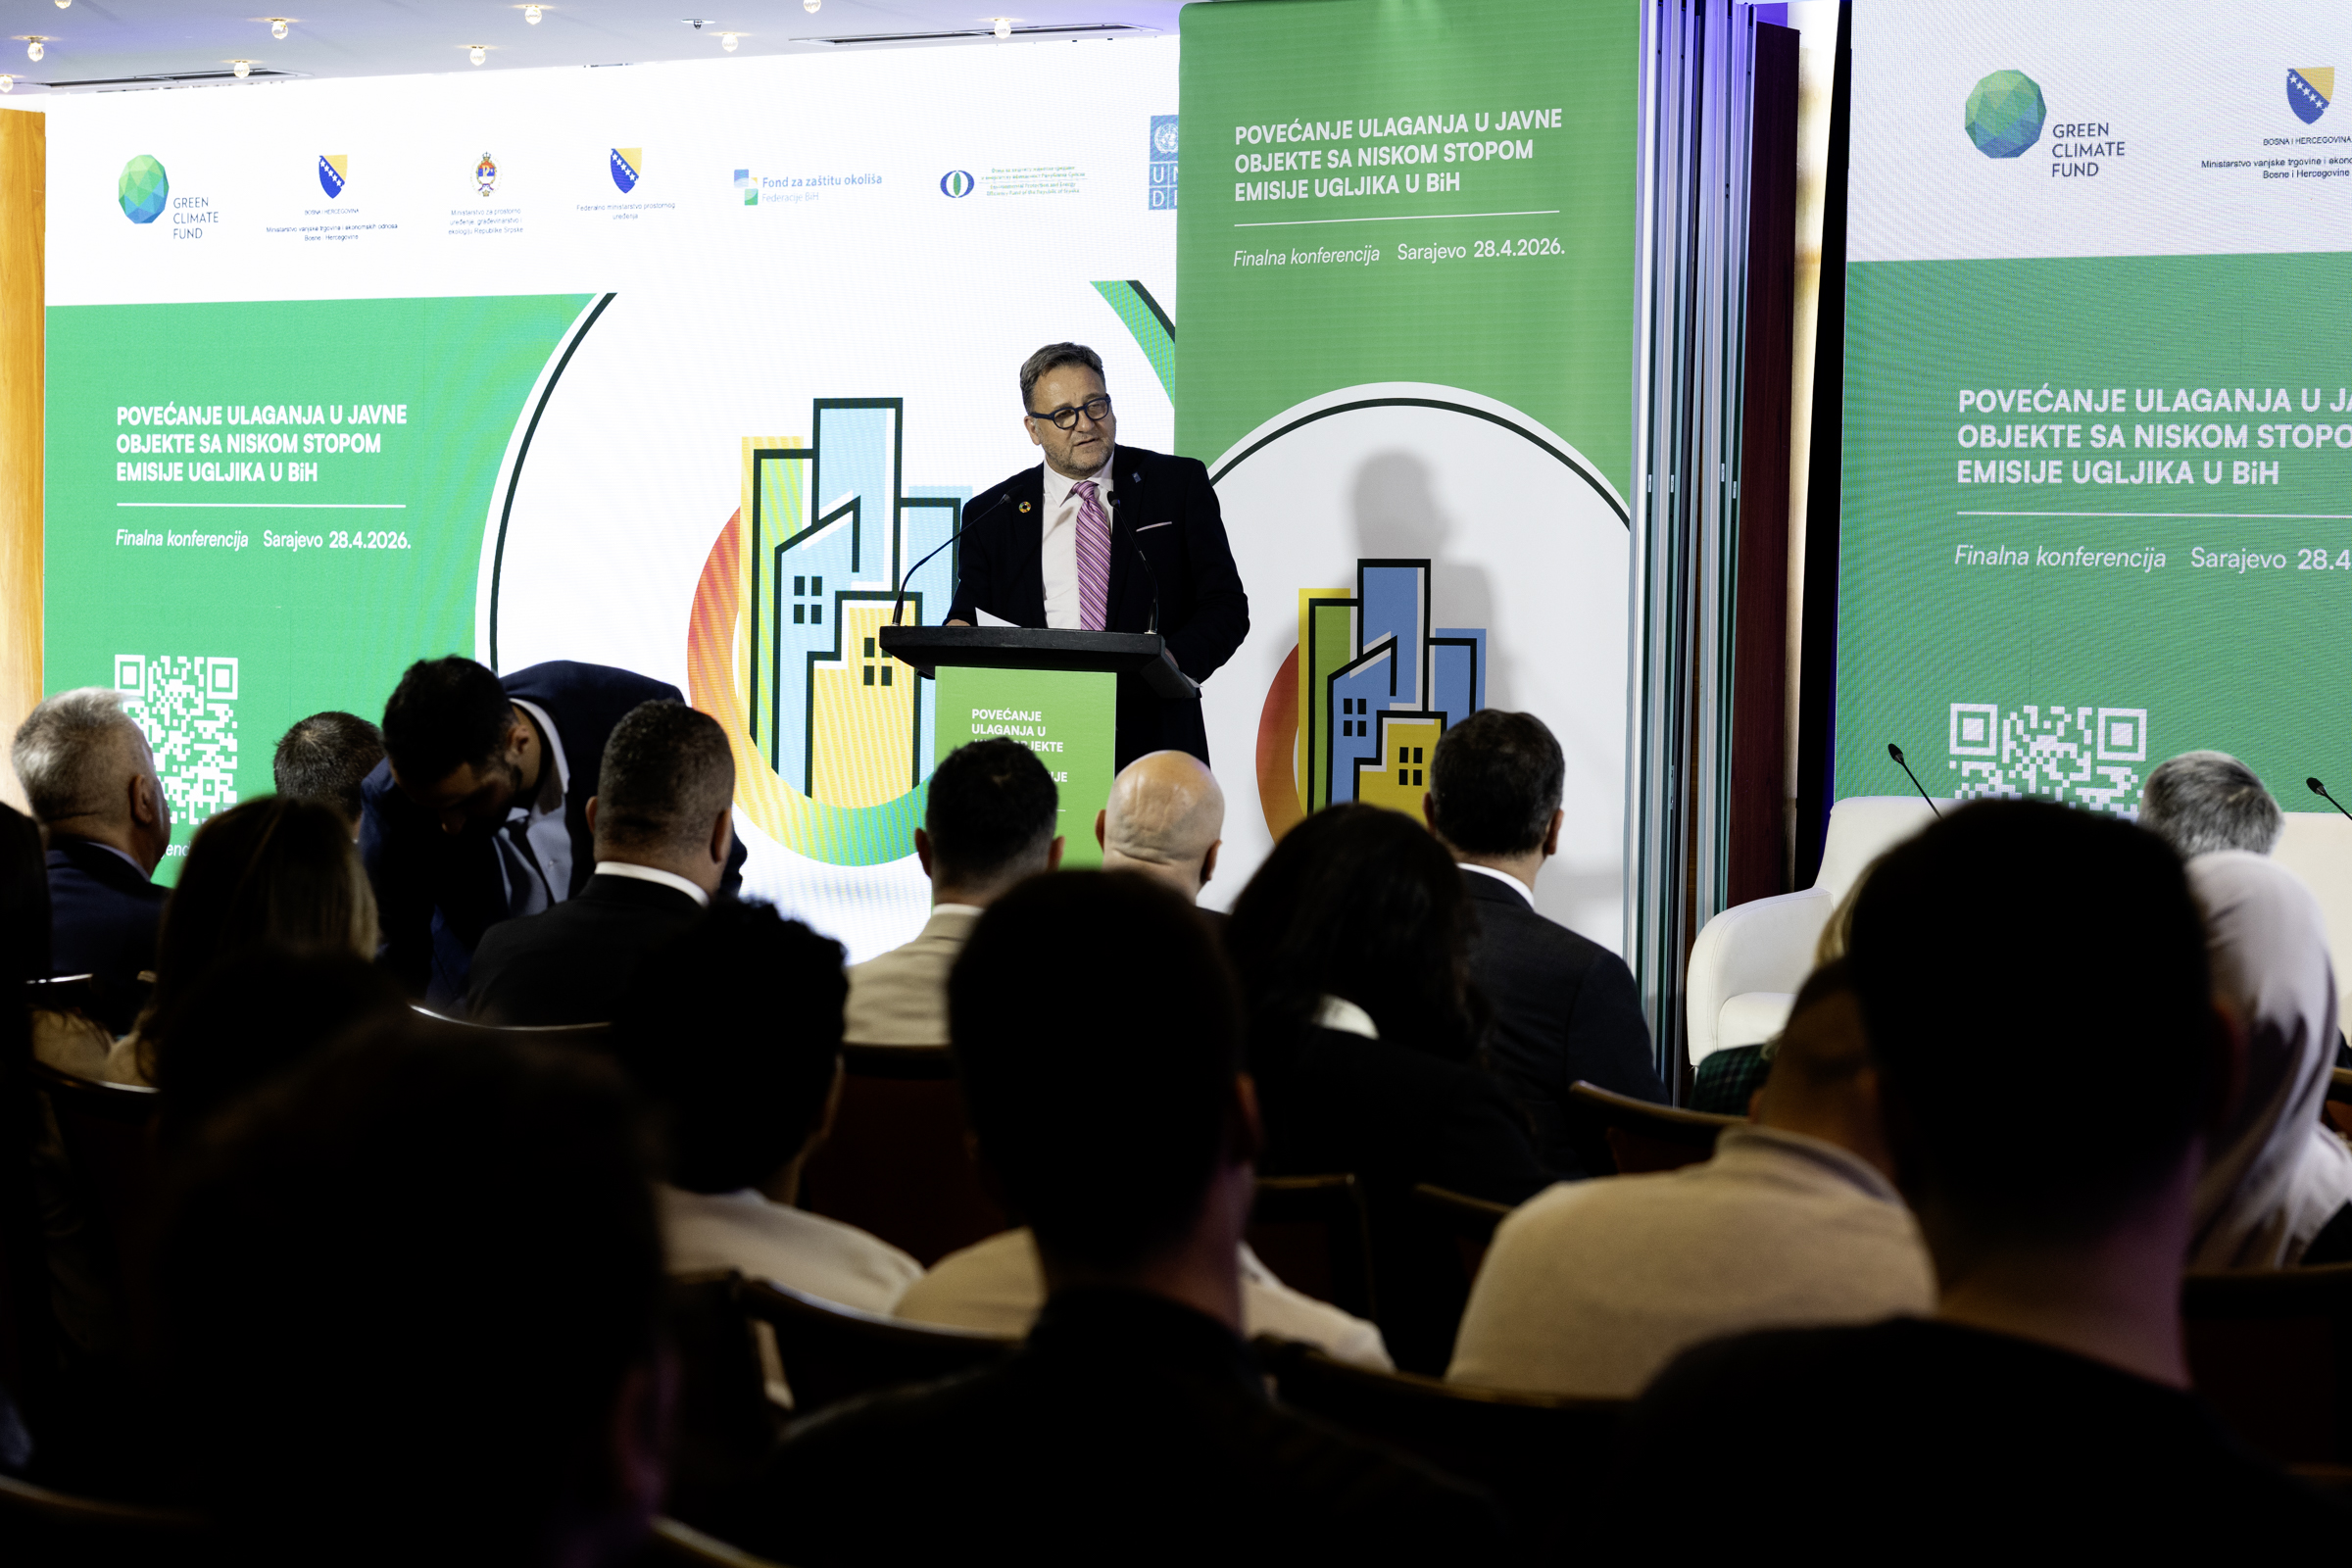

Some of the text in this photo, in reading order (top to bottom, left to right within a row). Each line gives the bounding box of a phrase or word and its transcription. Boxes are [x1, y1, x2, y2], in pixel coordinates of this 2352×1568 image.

[1235, 108, 1562, 145] POVEĆANJE ULAGANJA U JAVNE
[2052, 122, 2110, 138] GREEN
[1235, 139, 1534, 173] OBJEKTE SA NISKOM STOPOM
[2052, 141, 2126, 158] CLIMATE
[2052, 162, 2099, 177] FUND
[2201, 160, 2251, 169] Ministarstvo
[2254, 159, 2285, 169] vanjske
[2287, 157, 2322, 169] trgovine
[762, 173, 883, 188] Fond za zaštitu okoliša
[2263, 170, 2289, 179] Bosne
[2296, 168, 2350, 179] Hercegovine
[1235, 172, 1460, 202] EMISIJE UGLJIKA U BiH
[173, 197, 209, 209] GREEN
[761, 192, 819, 204] Federacije BiH
[173, 212, 219, 224] CLIMATE
[173, 227, 203, 239] FUND
[1233, 237, 1566, 268] Finalna konferencija Sarajevo 28.4.2026.
[1958, 383, 2127, 413] POVEĆANJE
[2135, 388, 2292, 413] ULAGANJA
[2301, 388, 2321, 413] U
[117, 401, 407, 425] POVEĆANJE ULAGANJA U JAVNE
[117, 433, 381, 454] OBJEKTE SA NISKOM STOPOM
[1957, 424, 2082, 449] OBJEKTE
[2090, 424, 2126, 448] SA
[2134, 423, 2248, 448] NISKOM
[117, 462, 318, 481] EMISIJE UGLJIKA U BiH
[1957, 460, 2279, 485] EMISIJE UGLJIKA U BiH
[116, 529, 412, 552] Finalna konferencija Sarajevo 28.4.2026.
[1954, 544, 2030, 566] Finalna
[2036, 545, 2167, 572] konferencija
[2190, 547, 2287, 574] Sarajevo
[971, 708, 1042, 721] POVEĆANJE
[971, 723, 1046, 737] ULAGANJA U
